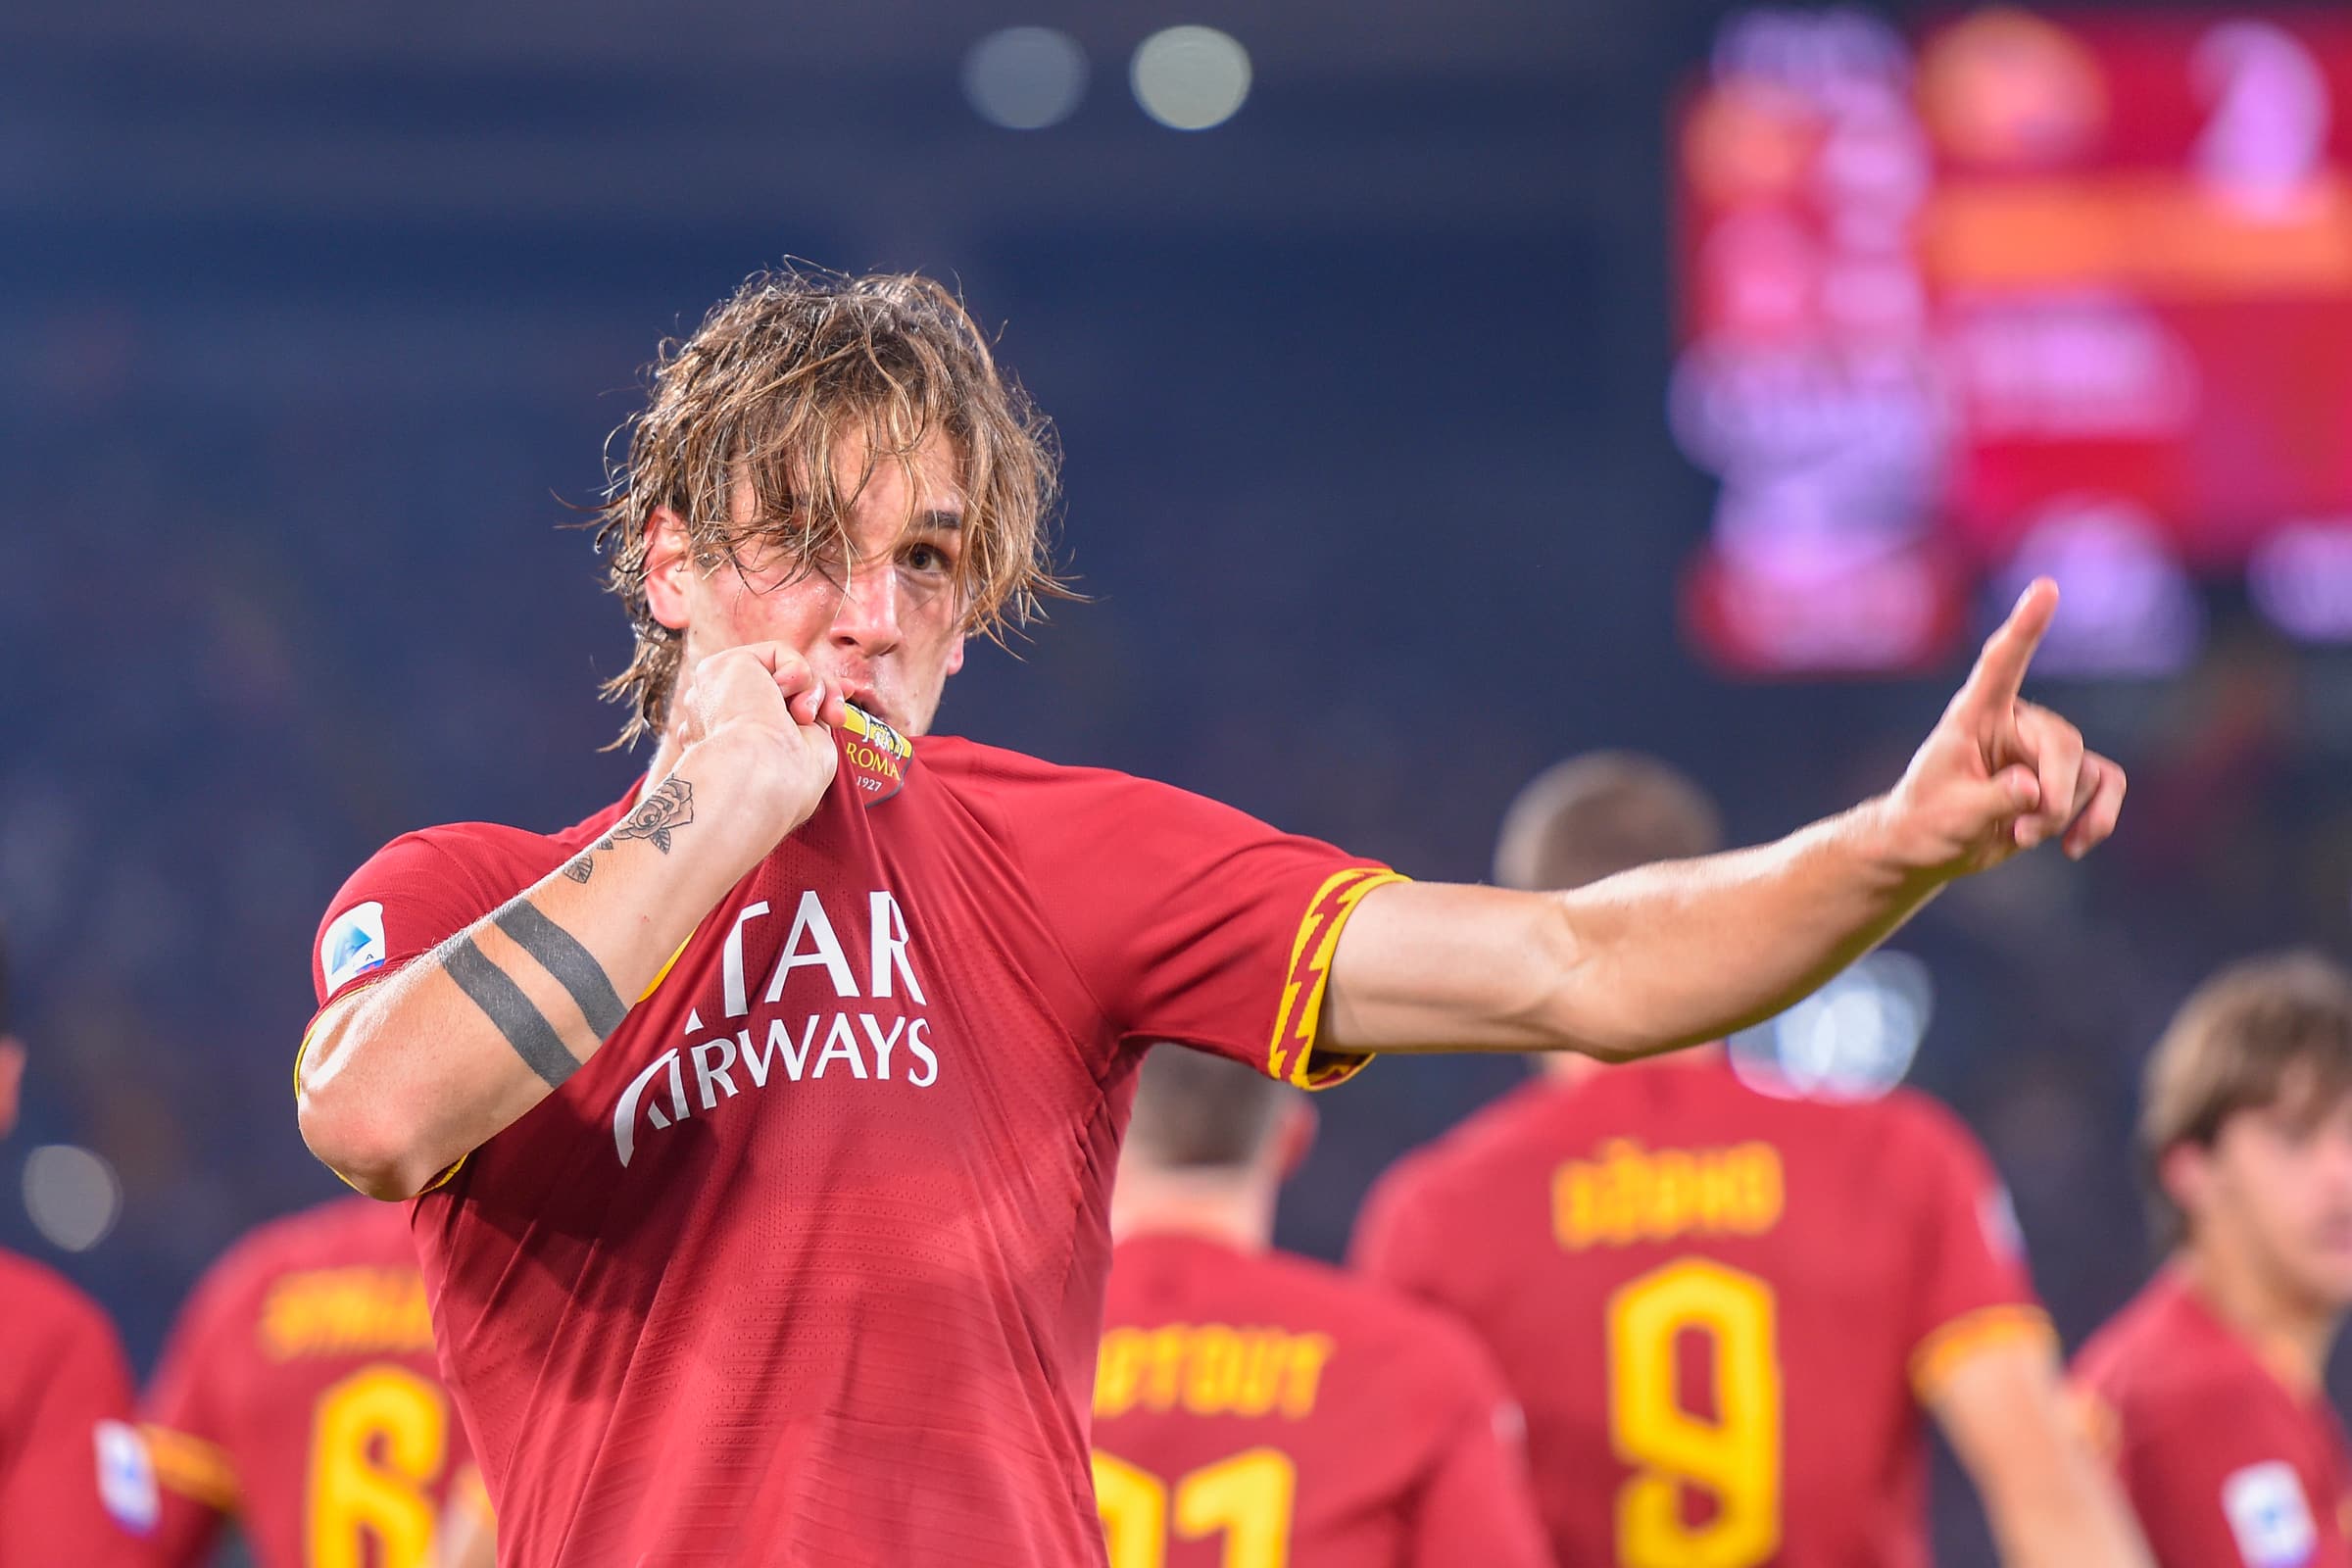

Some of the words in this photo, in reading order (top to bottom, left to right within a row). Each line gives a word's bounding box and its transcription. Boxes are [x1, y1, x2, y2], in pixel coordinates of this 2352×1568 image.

[847, 742, 901, 781] ROMA
[858, 776, 882, 792] 1927
[685, 890, 927, 1035] TAR
[304, 1362, 449, 1568] 6
[1605, 1256, 1783, 1568] 9
